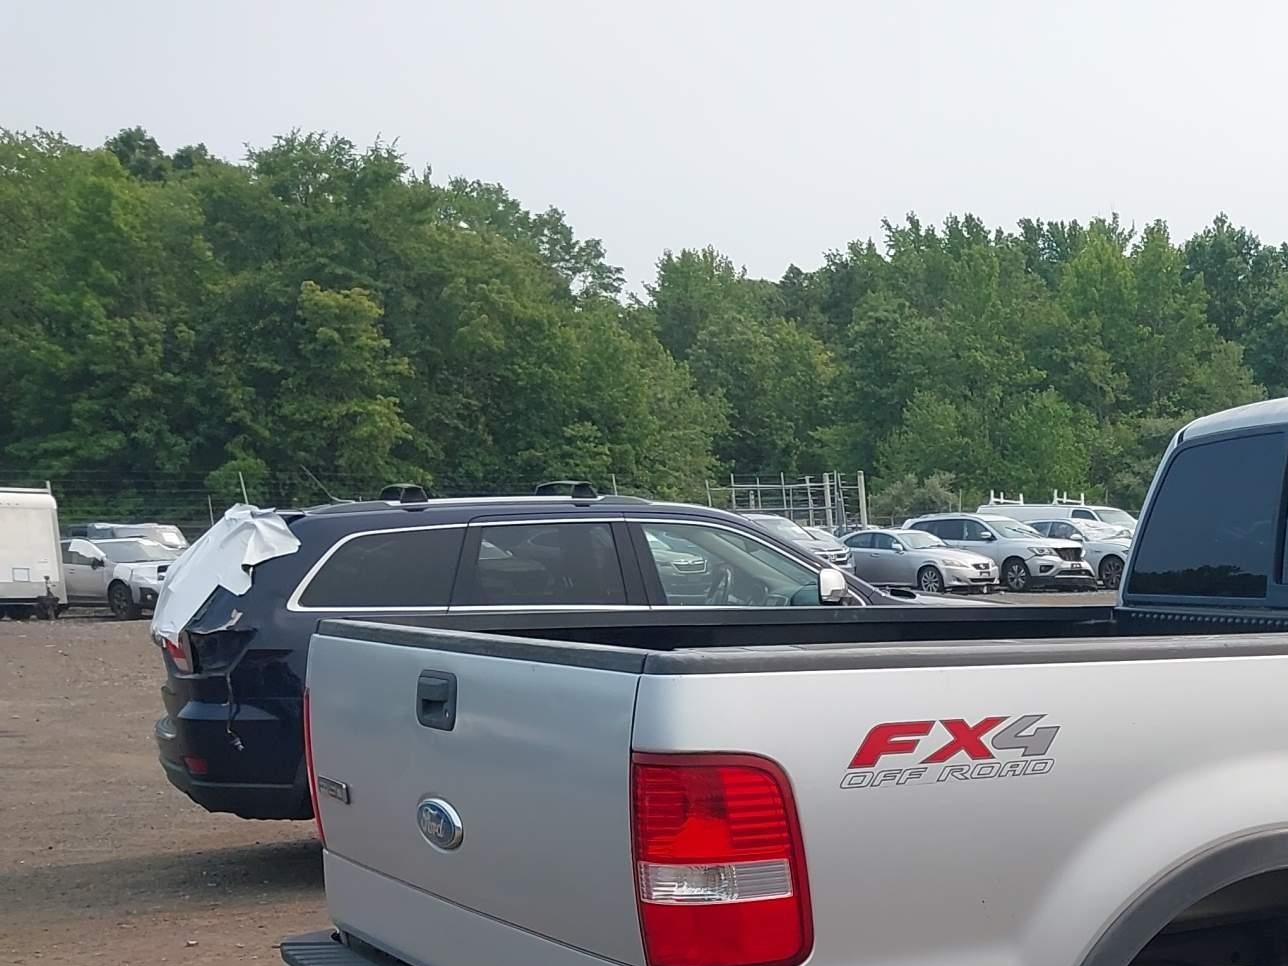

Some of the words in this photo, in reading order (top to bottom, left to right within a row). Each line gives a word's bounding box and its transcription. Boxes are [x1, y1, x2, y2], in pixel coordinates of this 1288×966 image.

[847, 713, 1060, 769] FX4
[840, 767, 928, 789] OFF
[936, 758, 1055, 782] ROAD
[420, 806, 445, 838] Ford
